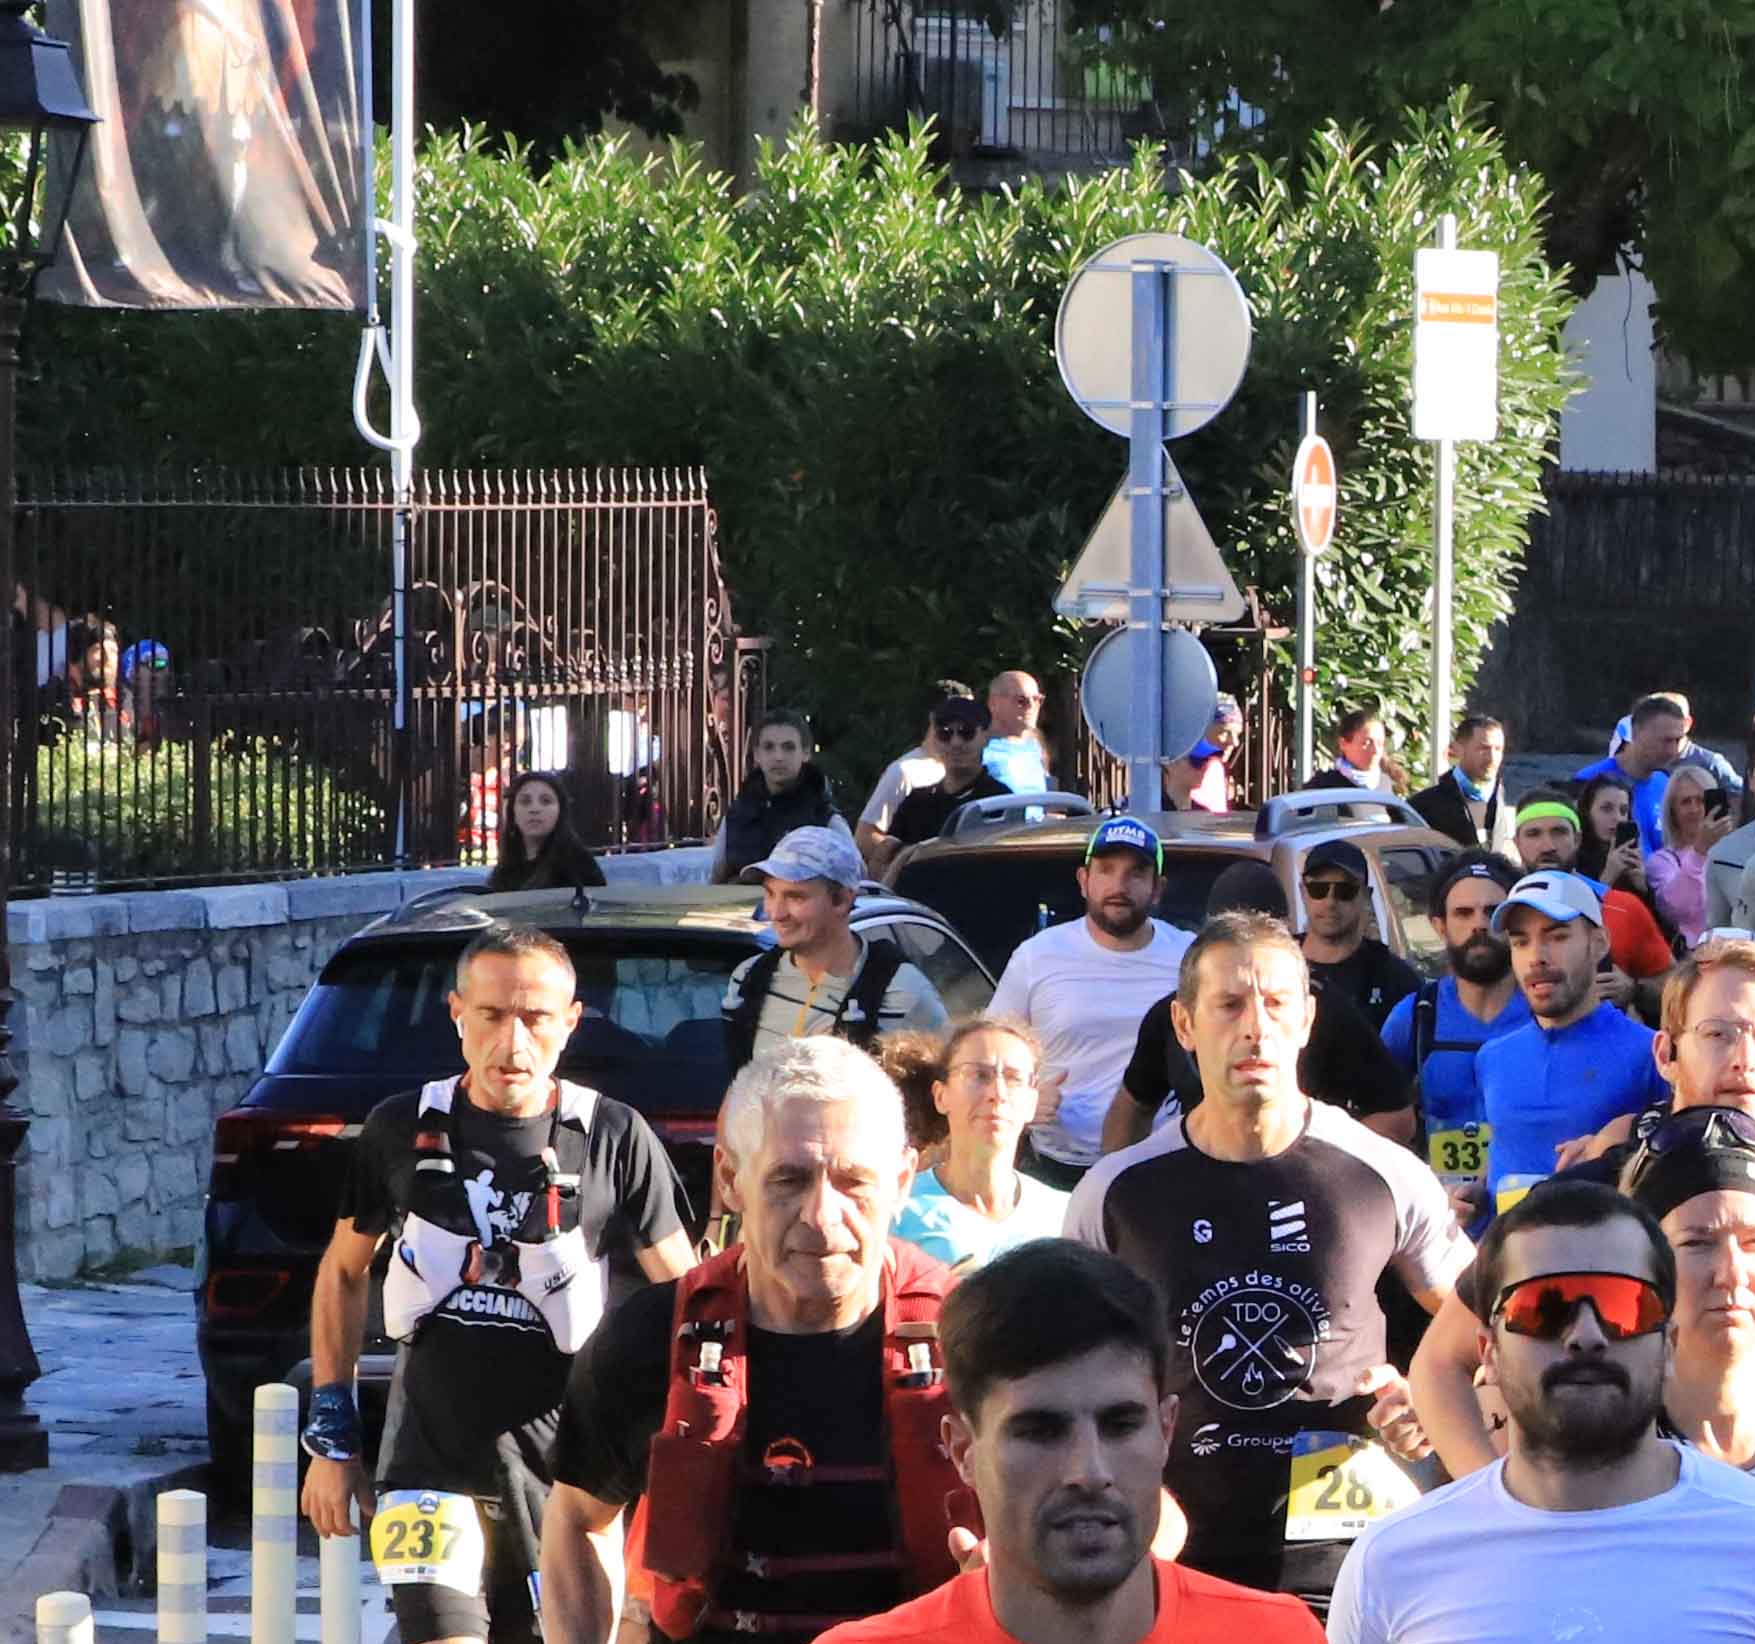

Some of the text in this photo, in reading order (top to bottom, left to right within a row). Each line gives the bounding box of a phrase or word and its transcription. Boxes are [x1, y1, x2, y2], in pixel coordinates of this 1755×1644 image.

[1270, 1243, 1310, 1252] SICO
[1176, 1323, 1192, 1347] Le
[1245, 1270, 1283, 1289] des
[1289, 1283, 1331, 1340] olivier
[1231, 1303, 1281, 1323] TDO
[384, 1520, 463, 1559] 237
